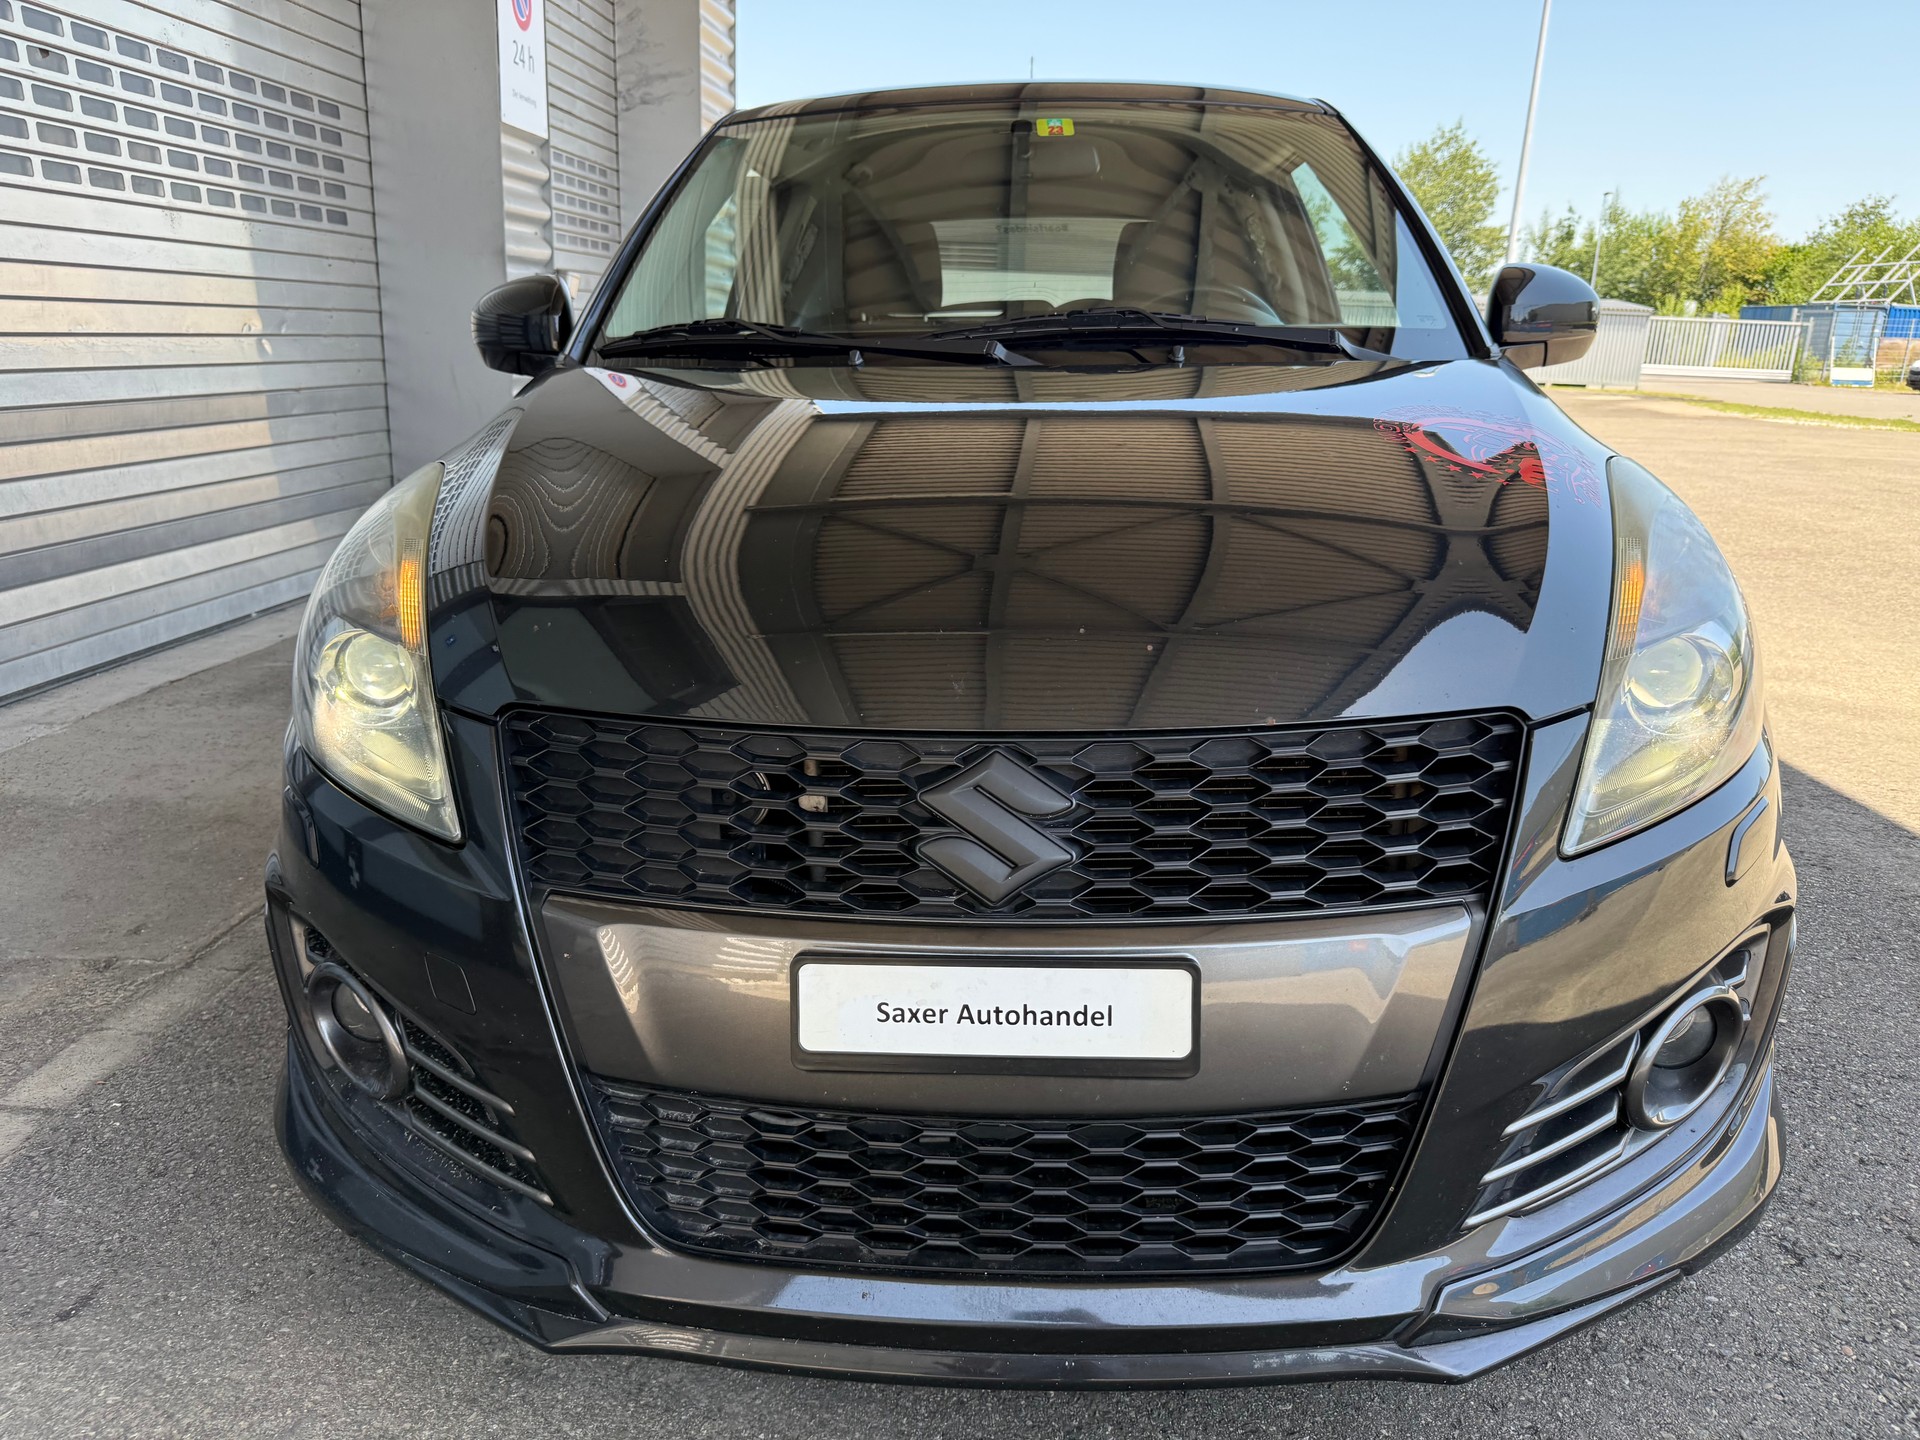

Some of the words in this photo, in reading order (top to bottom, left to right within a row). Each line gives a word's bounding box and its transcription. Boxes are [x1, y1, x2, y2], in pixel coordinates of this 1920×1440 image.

[512, 40, 525, 69] 24
[528, 46, 535, 74] h
[876, 1002, 949, 1024] Saxer
[956, 1003, 1113, 1027] Autohandel
